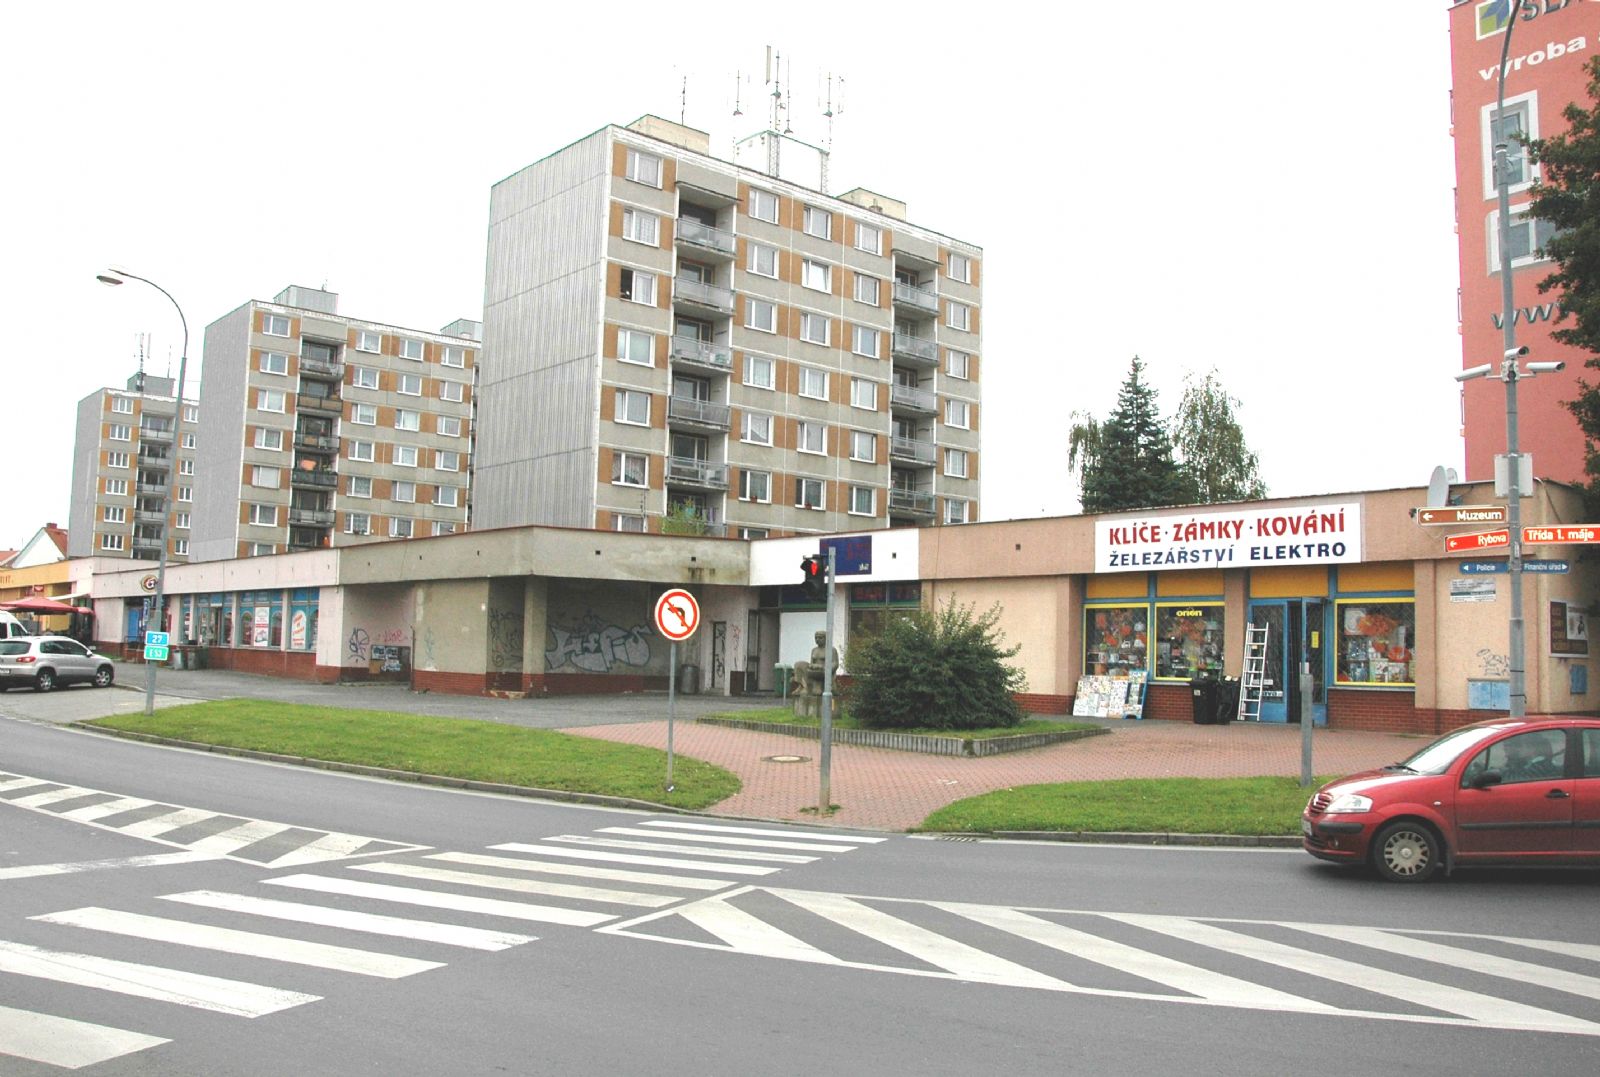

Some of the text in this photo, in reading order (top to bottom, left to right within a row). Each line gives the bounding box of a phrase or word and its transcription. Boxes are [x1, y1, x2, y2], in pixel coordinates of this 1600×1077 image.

[1456, 510, 1503, 521] Muzeum
[1109, 508, 1346, 545] KLÍČE ZÁMKY KOVÁNÍ
[1478, 534, 1507, 547] Rybova
[1527, 528, 1595, 542] Třída 1. máje
[1109, 541, 1347, 567] ŽELEZÁŘSTVÍ ELEKTRO
[152, 634, 163, 645] 27
